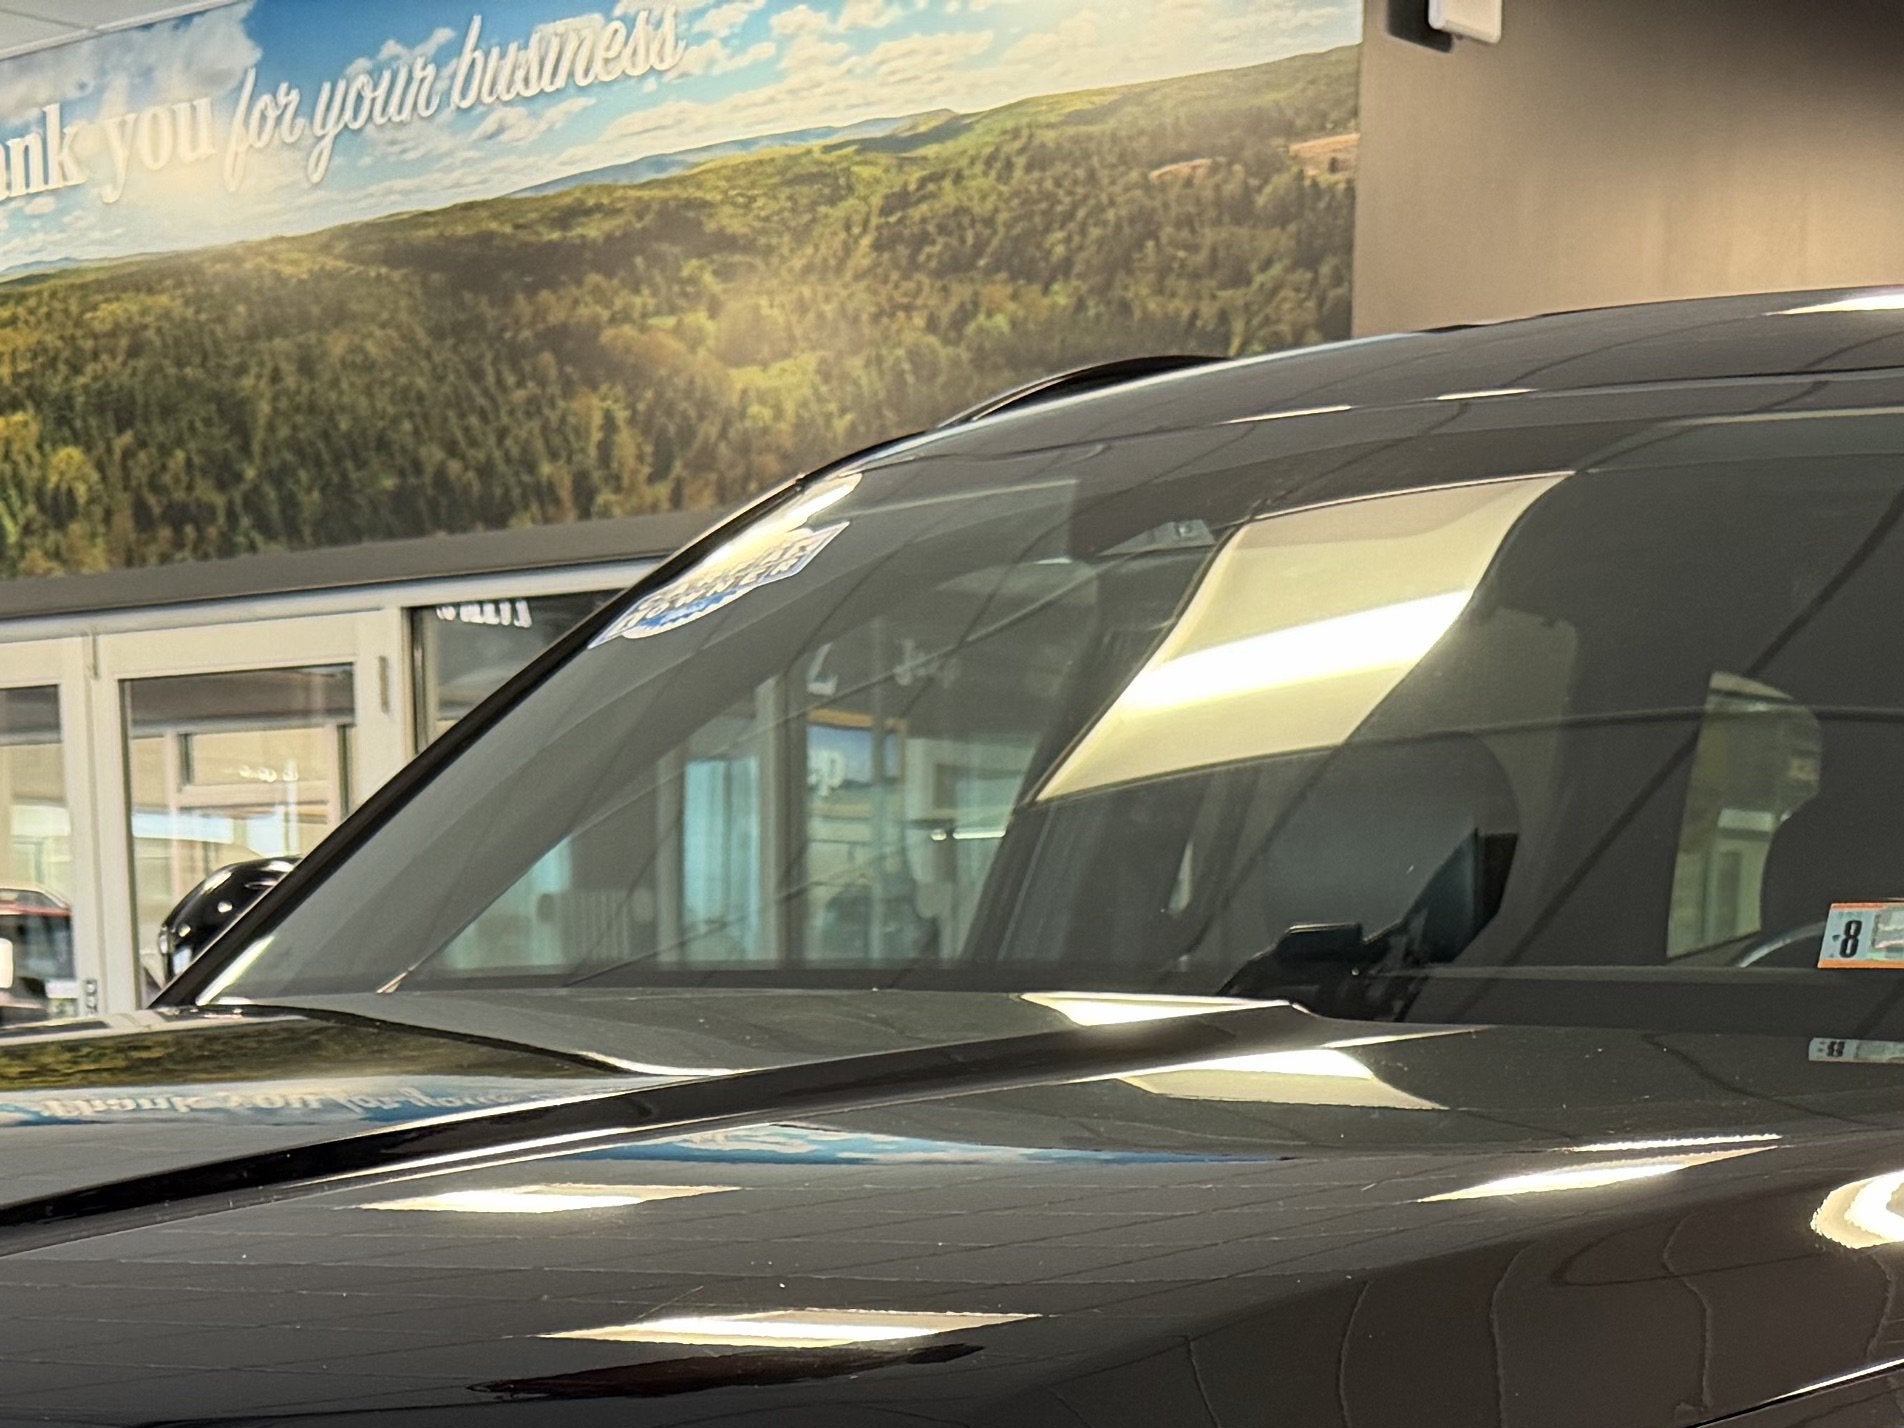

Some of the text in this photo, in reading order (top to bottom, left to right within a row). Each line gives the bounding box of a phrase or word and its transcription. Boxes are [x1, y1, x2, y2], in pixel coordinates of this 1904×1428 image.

[99, 98, 216, 204] you
[223, 68, 305, 193] for
[307, 55, 440, 184] your
[450, 10, 686, 110] business
[1839, 920, 1862, 958] 8
